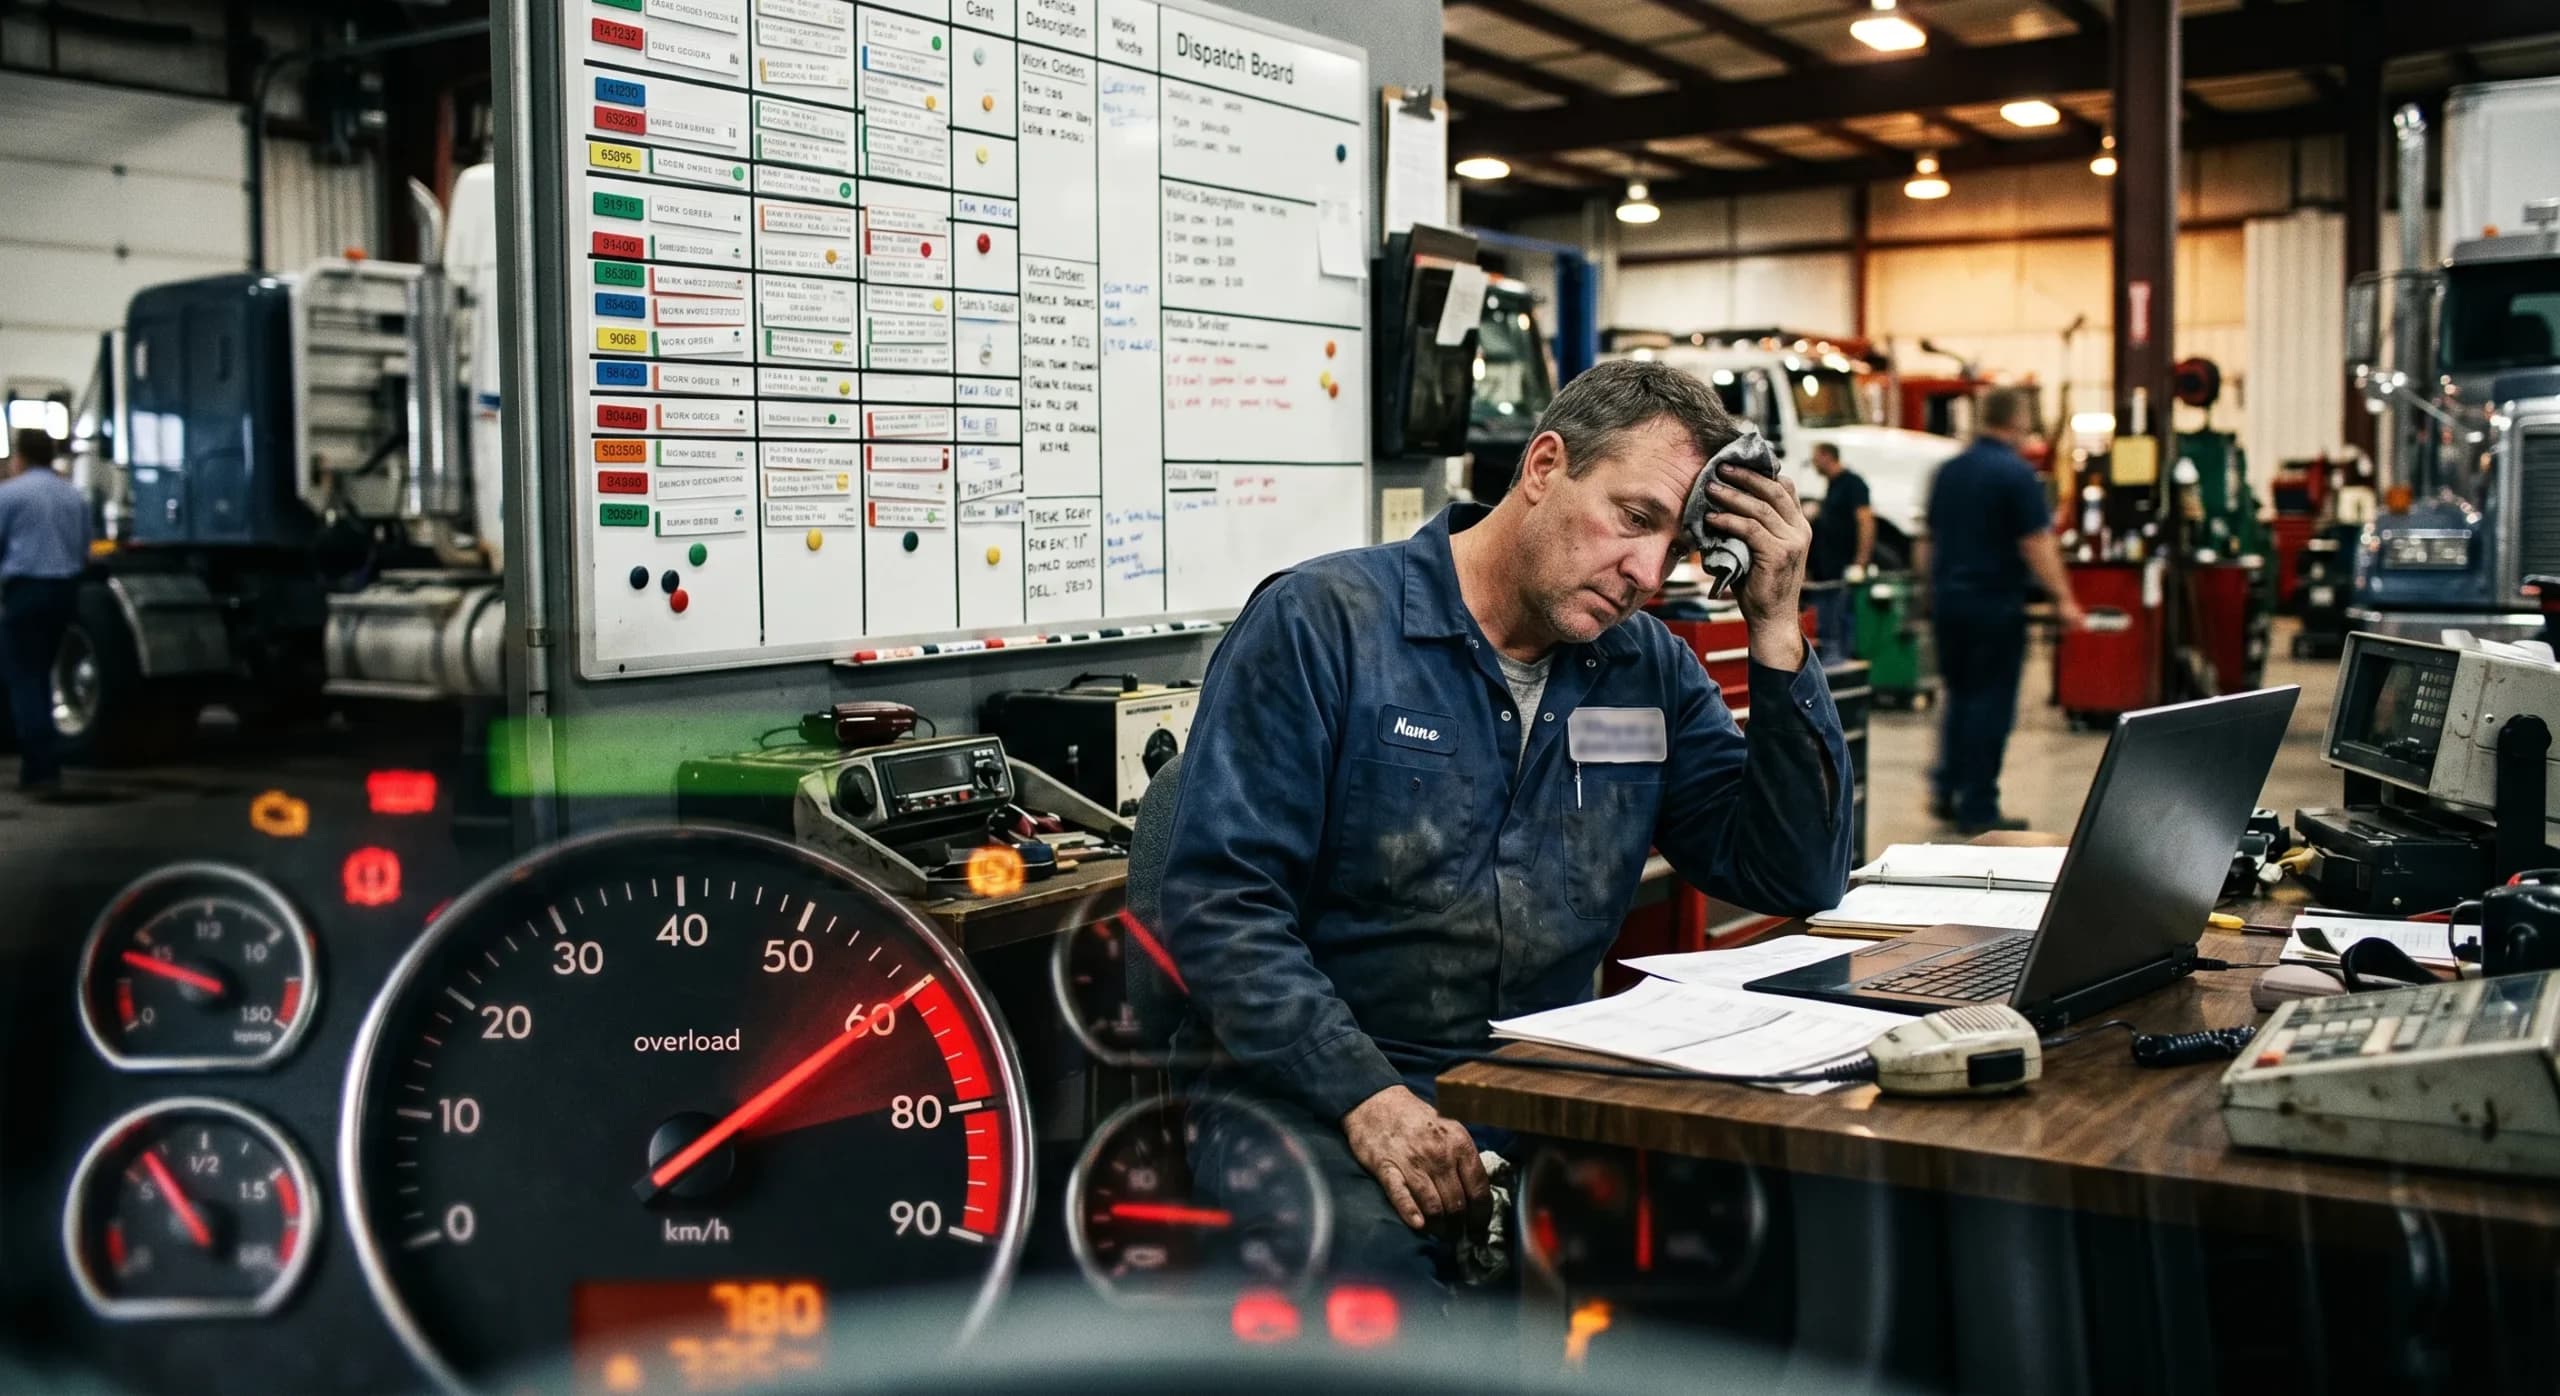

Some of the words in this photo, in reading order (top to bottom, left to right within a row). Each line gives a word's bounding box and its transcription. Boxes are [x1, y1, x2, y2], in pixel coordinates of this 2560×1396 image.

[1177, 33, 1246, 73] Dispatch
[1251, 52, 1295, 86] Board
[610, 333, 637, 345] 9068
[1394, 716, 1440, 742] Name
[655, 913, 709, 947] 40
[552, 941, 604, 975] 30
[762, 940, 814, 973] 50
[480, 1006, 532, 1040] 20
[845, 1004, 897, 1038] 60
[633, 1029, 741, 1054] overload
[439, 1099, 480, 1134] 10
[891, 1095, 943, 1130] 80
[446, 1206, 475, 1241] 0
[664, 1218, 730, 1244] km/h
[890, 1201, 942, 1237] 90
